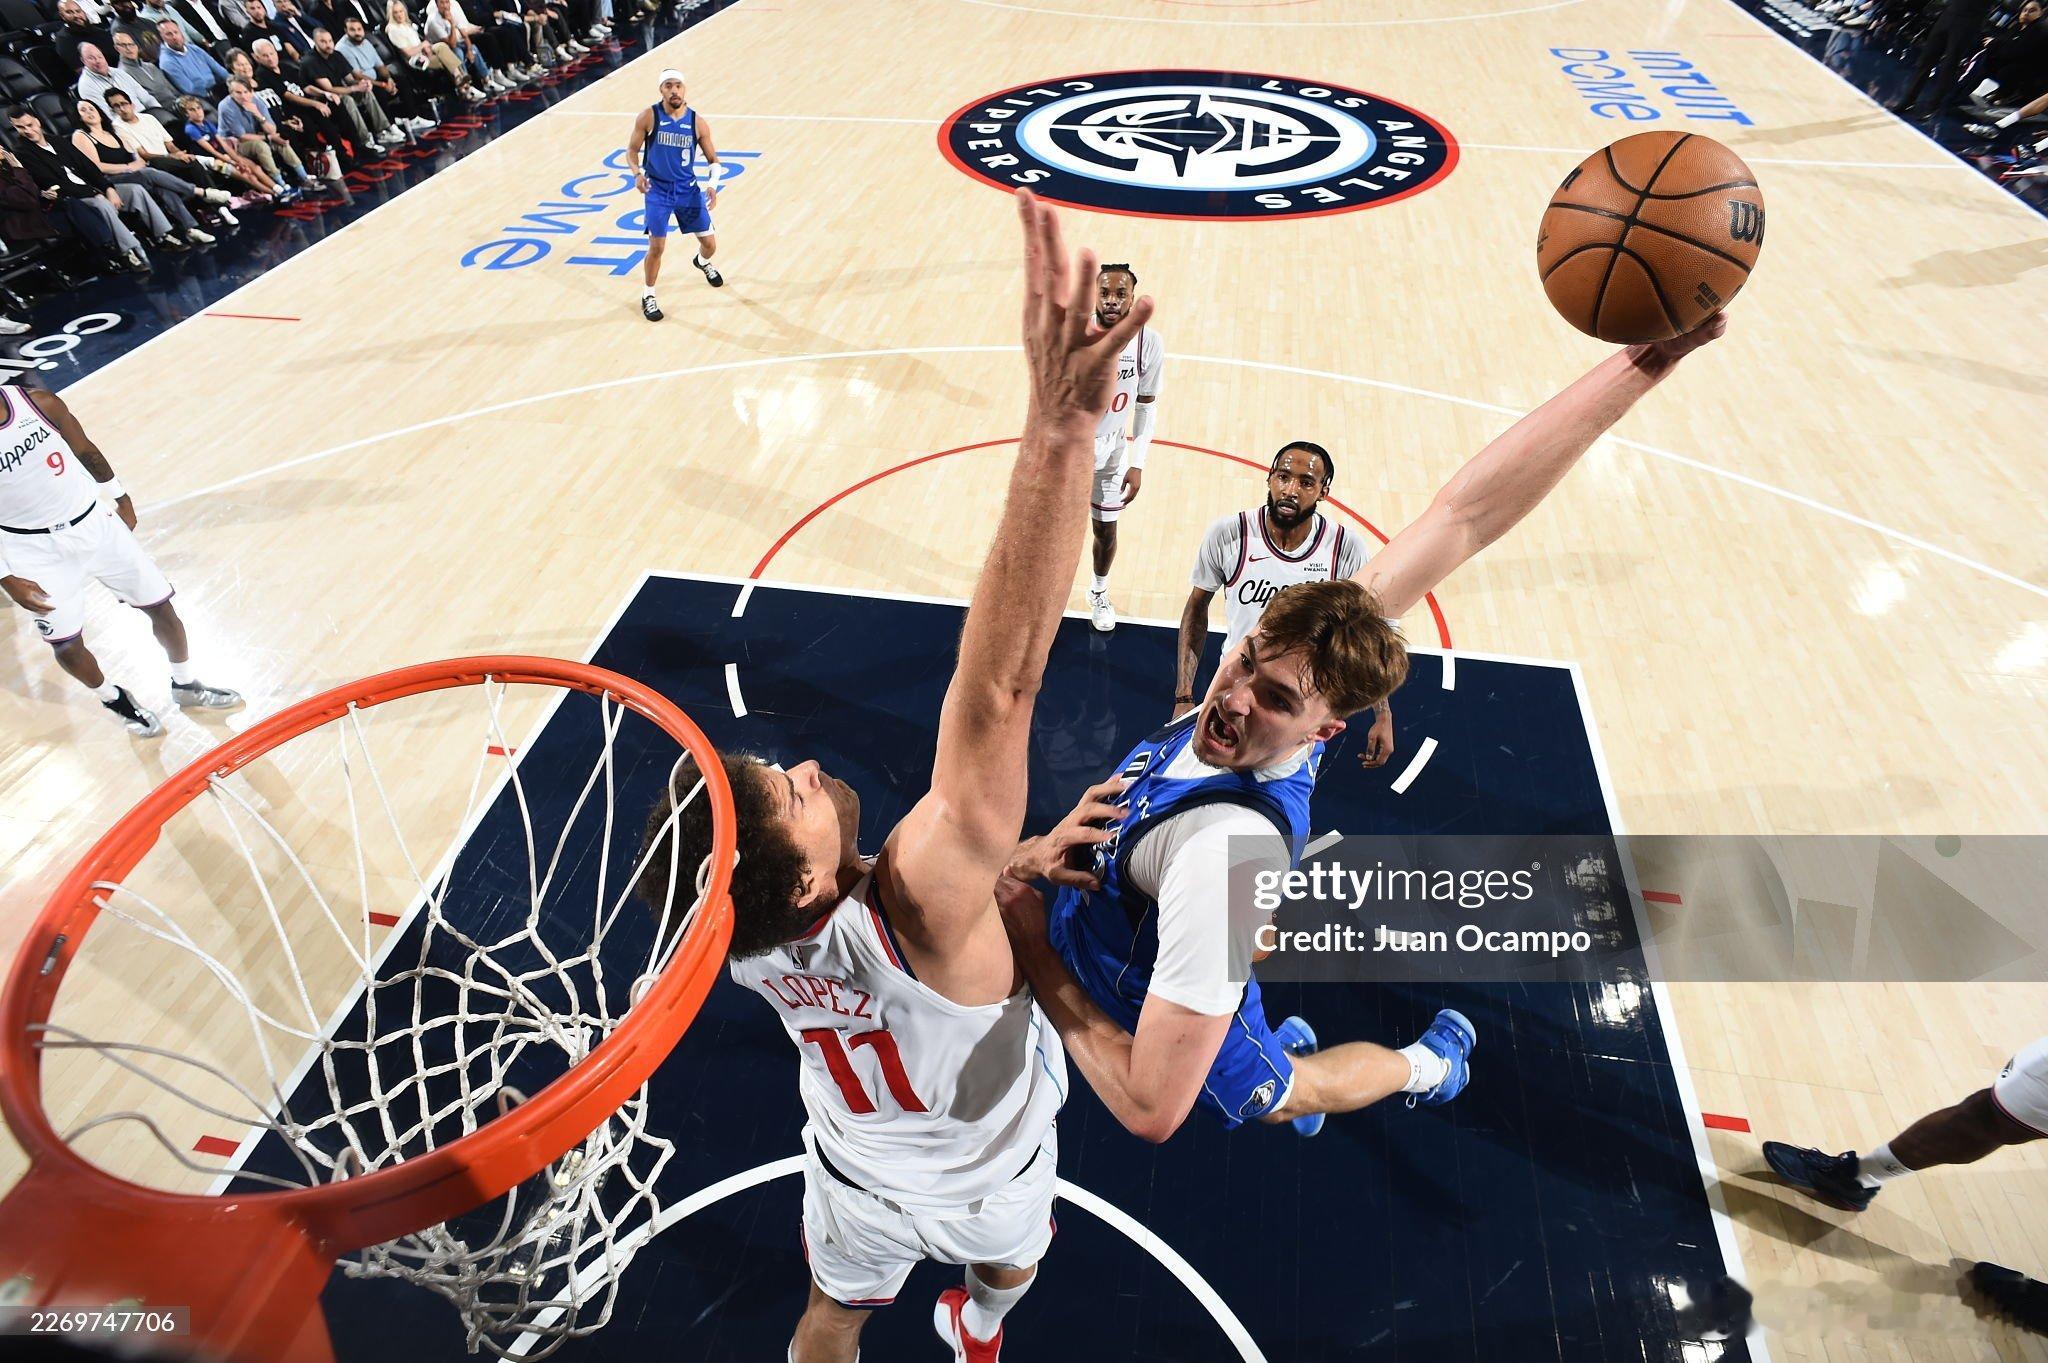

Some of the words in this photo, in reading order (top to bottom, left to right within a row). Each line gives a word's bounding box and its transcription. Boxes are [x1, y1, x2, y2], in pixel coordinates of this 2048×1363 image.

[1259, 79, 1369, 110] LOS
[657, 130, 693, 148] DALLAS
[966, 80, 1095, 185] CLIPPERS
[681, 148, 691, 167] 9
[1254, 119, 1426, 209] ANGELES
[46, 451, 65, 477] 9
[761, 974, 873, 1020] LOPEZ
[800, 1028, 931, 1114] 11
